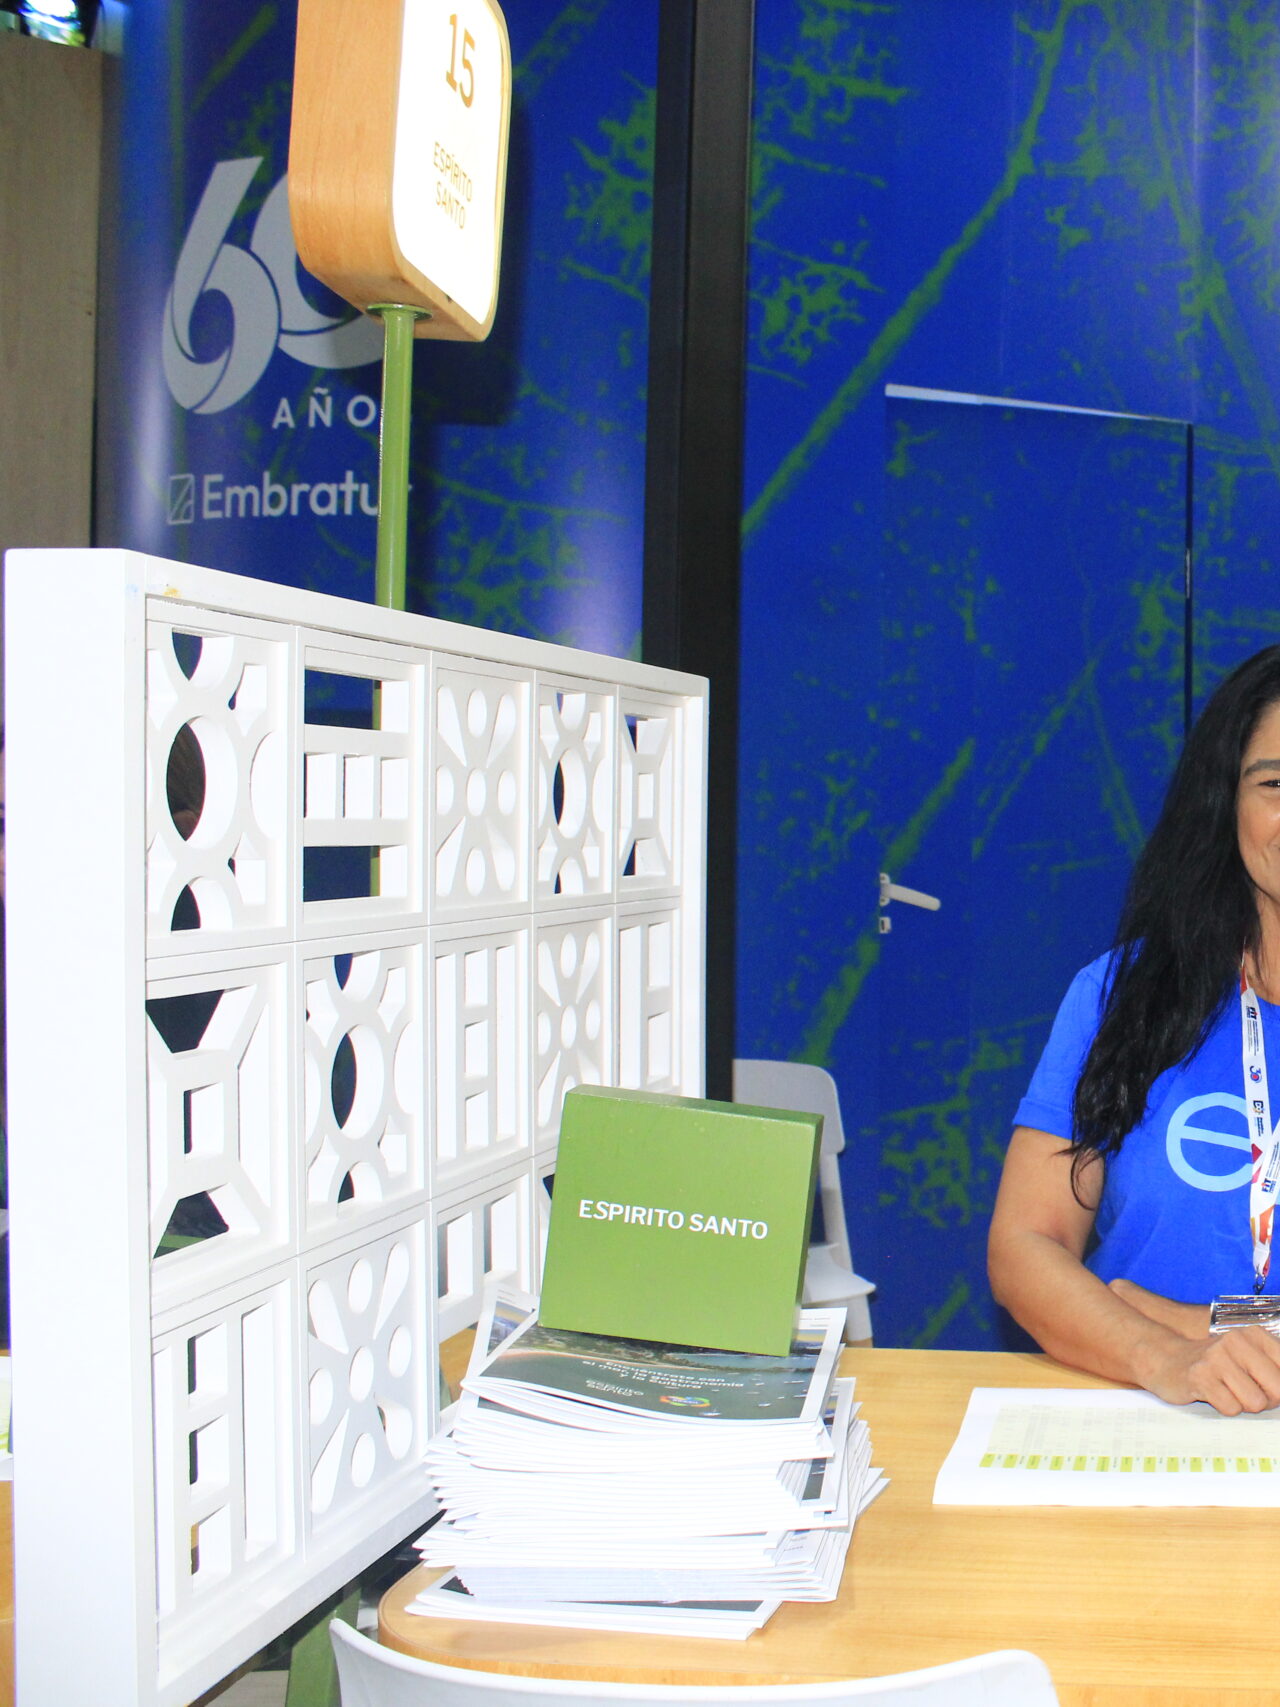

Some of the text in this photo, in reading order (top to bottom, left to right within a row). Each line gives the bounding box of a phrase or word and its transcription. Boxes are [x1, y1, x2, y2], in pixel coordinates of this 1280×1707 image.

[446, 13, 476, 108] 15
[433, 141, 472, 202] ESPÍRITO
[437, 181, 466, 230] SANTO
[272, 387, 411, 429] AÑO
[202, 470, 412, 520] Embratu
[579, 1199, 769, 1240] ESPIRITO SANTO
